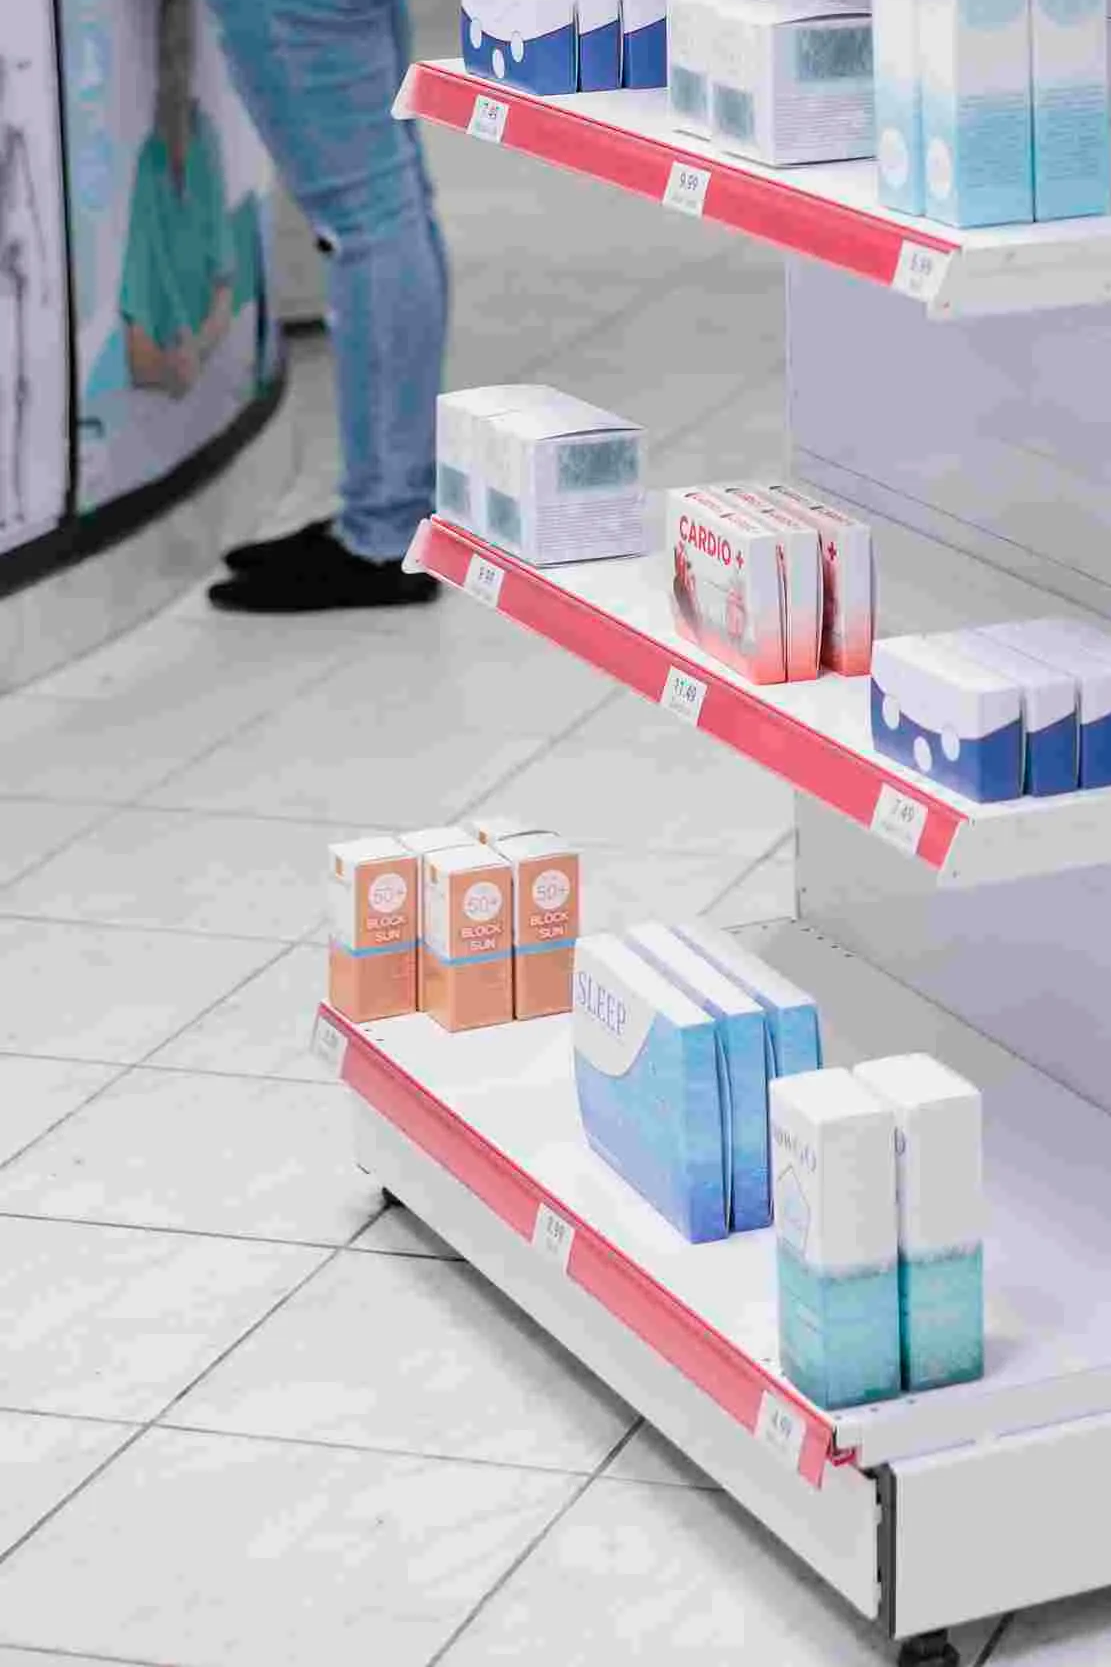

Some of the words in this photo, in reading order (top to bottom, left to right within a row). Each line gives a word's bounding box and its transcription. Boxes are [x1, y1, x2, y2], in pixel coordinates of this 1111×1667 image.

[679, 515, 732, 566] CARDIO
[373, 886, 405, 905] 50+
[536, 883, 568, 903] 50+
[467, 896, 498, 914] 50+
[366, 915, 407, 930] BLOCK
[530, 912, 569, 927] BLOCK
[375, 929, 401, 943] SUN
[461, 924, 502, 939] BLOCK
[539, 926, 565, 939] SUN
[470, 938, 496, 951] SUN
[577, 971, 627, 1036] SLEEP
